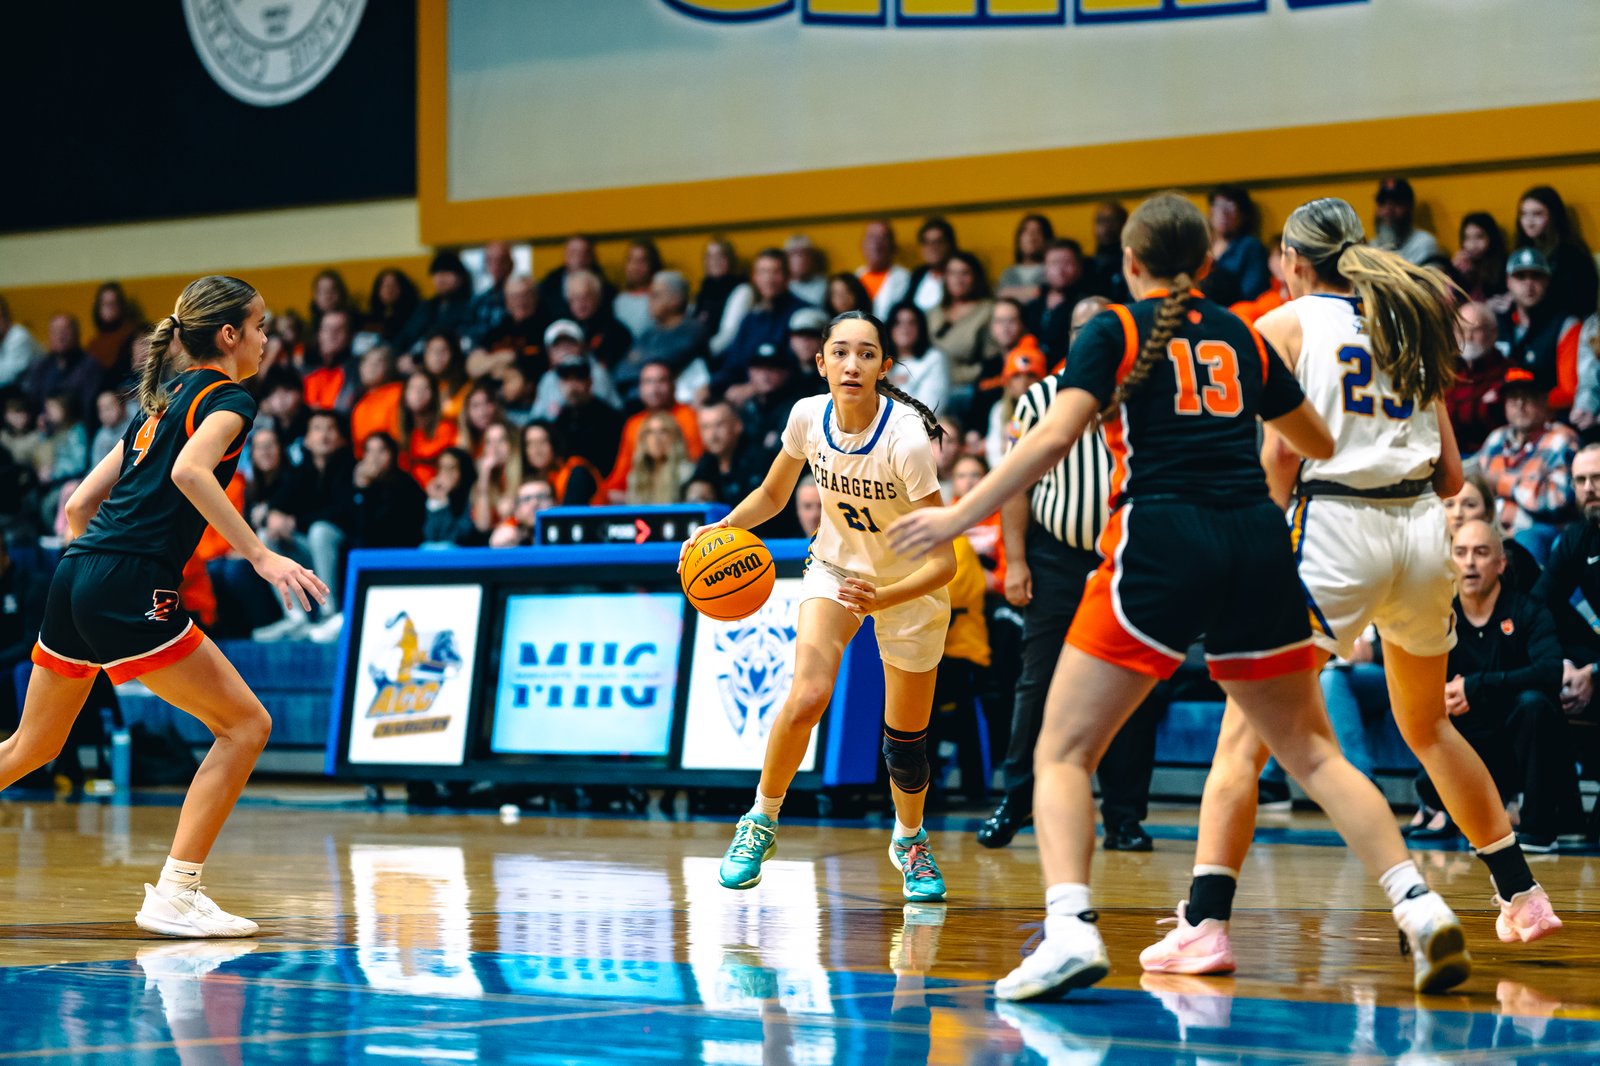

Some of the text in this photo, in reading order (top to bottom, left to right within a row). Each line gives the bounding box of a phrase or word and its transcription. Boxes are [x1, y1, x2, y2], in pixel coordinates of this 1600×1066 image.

[1167, 338, 1243, 417] 13
[132, 407, 168, 466] 4
[814, 464, 897, 500] CHARGERS
[837, 502, 881, 533] 21
[703, 552, 763, 587] Wilson
[367, 681, 440, 717] ACC
